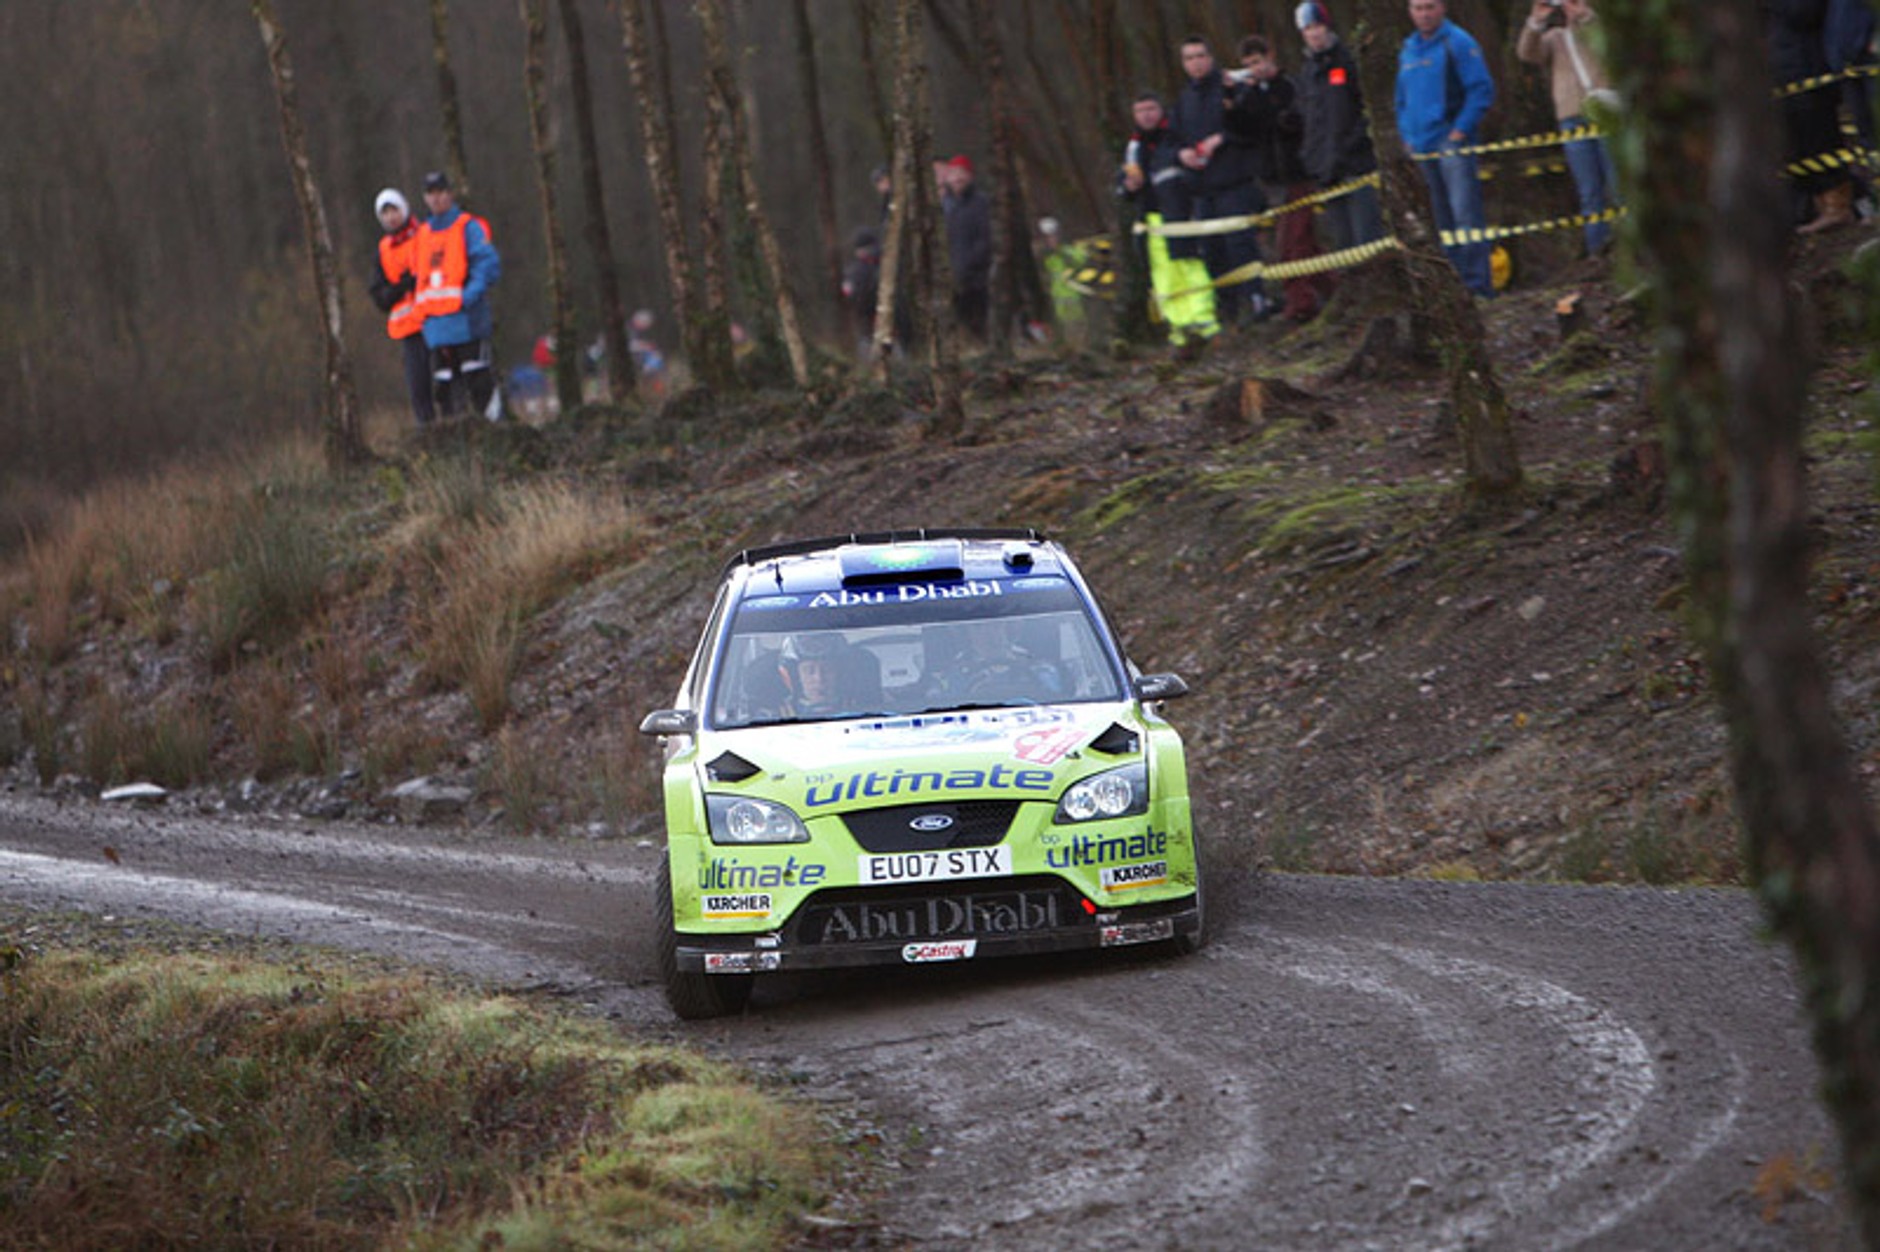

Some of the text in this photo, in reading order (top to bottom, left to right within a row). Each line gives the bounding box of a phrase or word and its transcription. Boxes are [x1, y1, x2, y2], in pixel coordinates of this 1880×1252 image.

[809, 589, 884, 608] Abu
[805, 764, 1054, 807] ultimate
[1047, 825, 1167, 868] ultimate
[698, 855, 827, 889] ultimate
[869, 848, 1000, 881] EU07 STX
[821, 905, 917, 942] Abu
